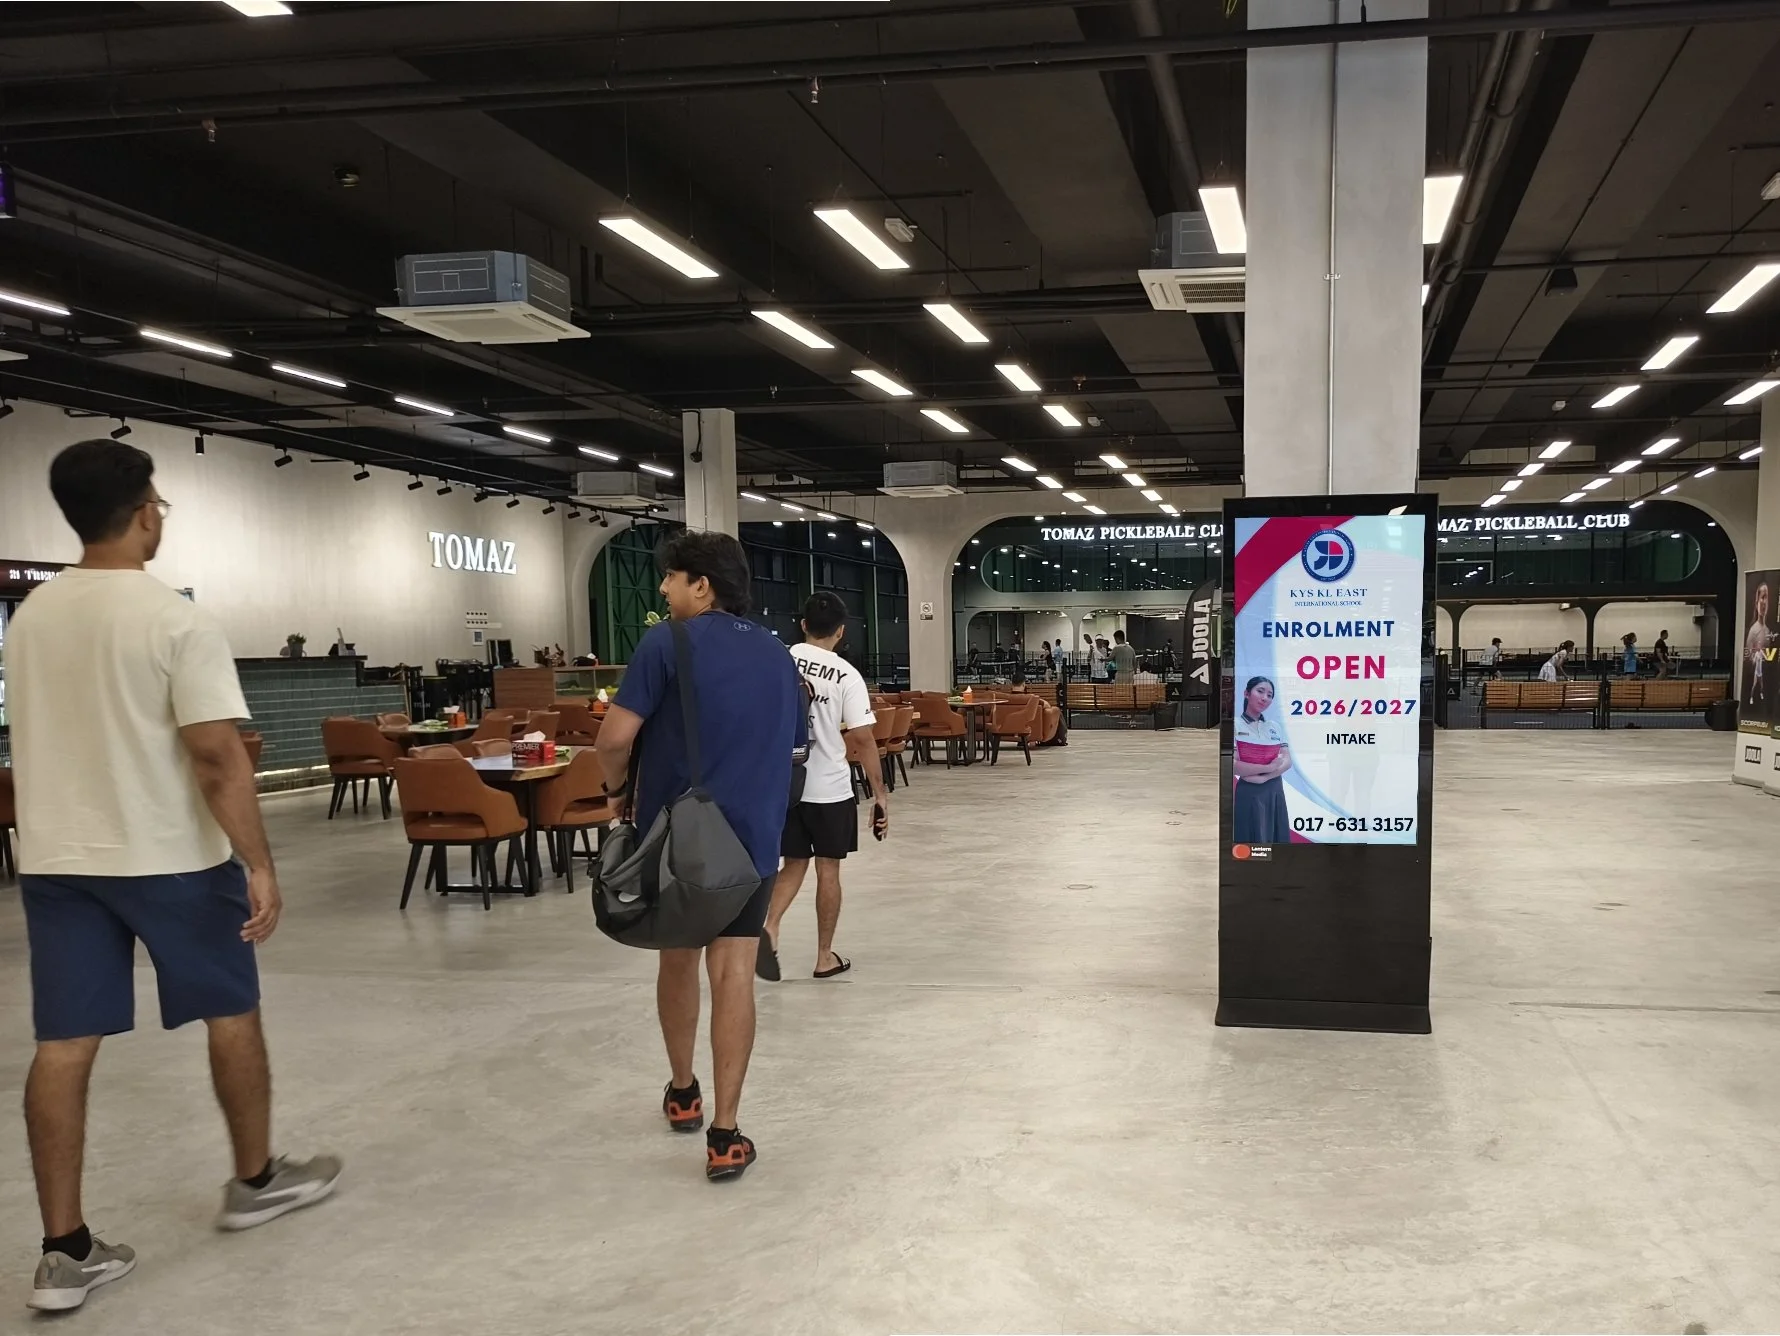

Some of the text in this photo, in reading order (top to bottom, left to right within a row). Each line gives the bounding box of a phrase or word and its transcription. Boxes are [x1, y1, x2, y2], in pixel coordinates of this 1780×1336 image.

[1437, 514, 1630, 532] MAZ PICKLEBALL CLUB
[1041, 526, 1095, 541] TOMAZ
[1100, 525, 1195, 540] PICKLEBALL
[427, 531, 517, 575] TOMAZ
[1290, 588, 1368, 598] KYS KL EAST
[1192, 598, 1212, 661] JOOLA
[1262, 620, 1395, 638] ENROLMENT
[794, 656, 848, 684] REMY
[1296, 655, 1386, 680] OPEN
[815, 694, 830, 705] IK
[1290, 699, 1417, 717] 2026/2027
[512, 742, 540, 751] PREMIER
[1326, 733, 1376, 745] INTAKE
[1293, 817, 1324, 832] 017
[1372, 817, 1414, 832] 3157
